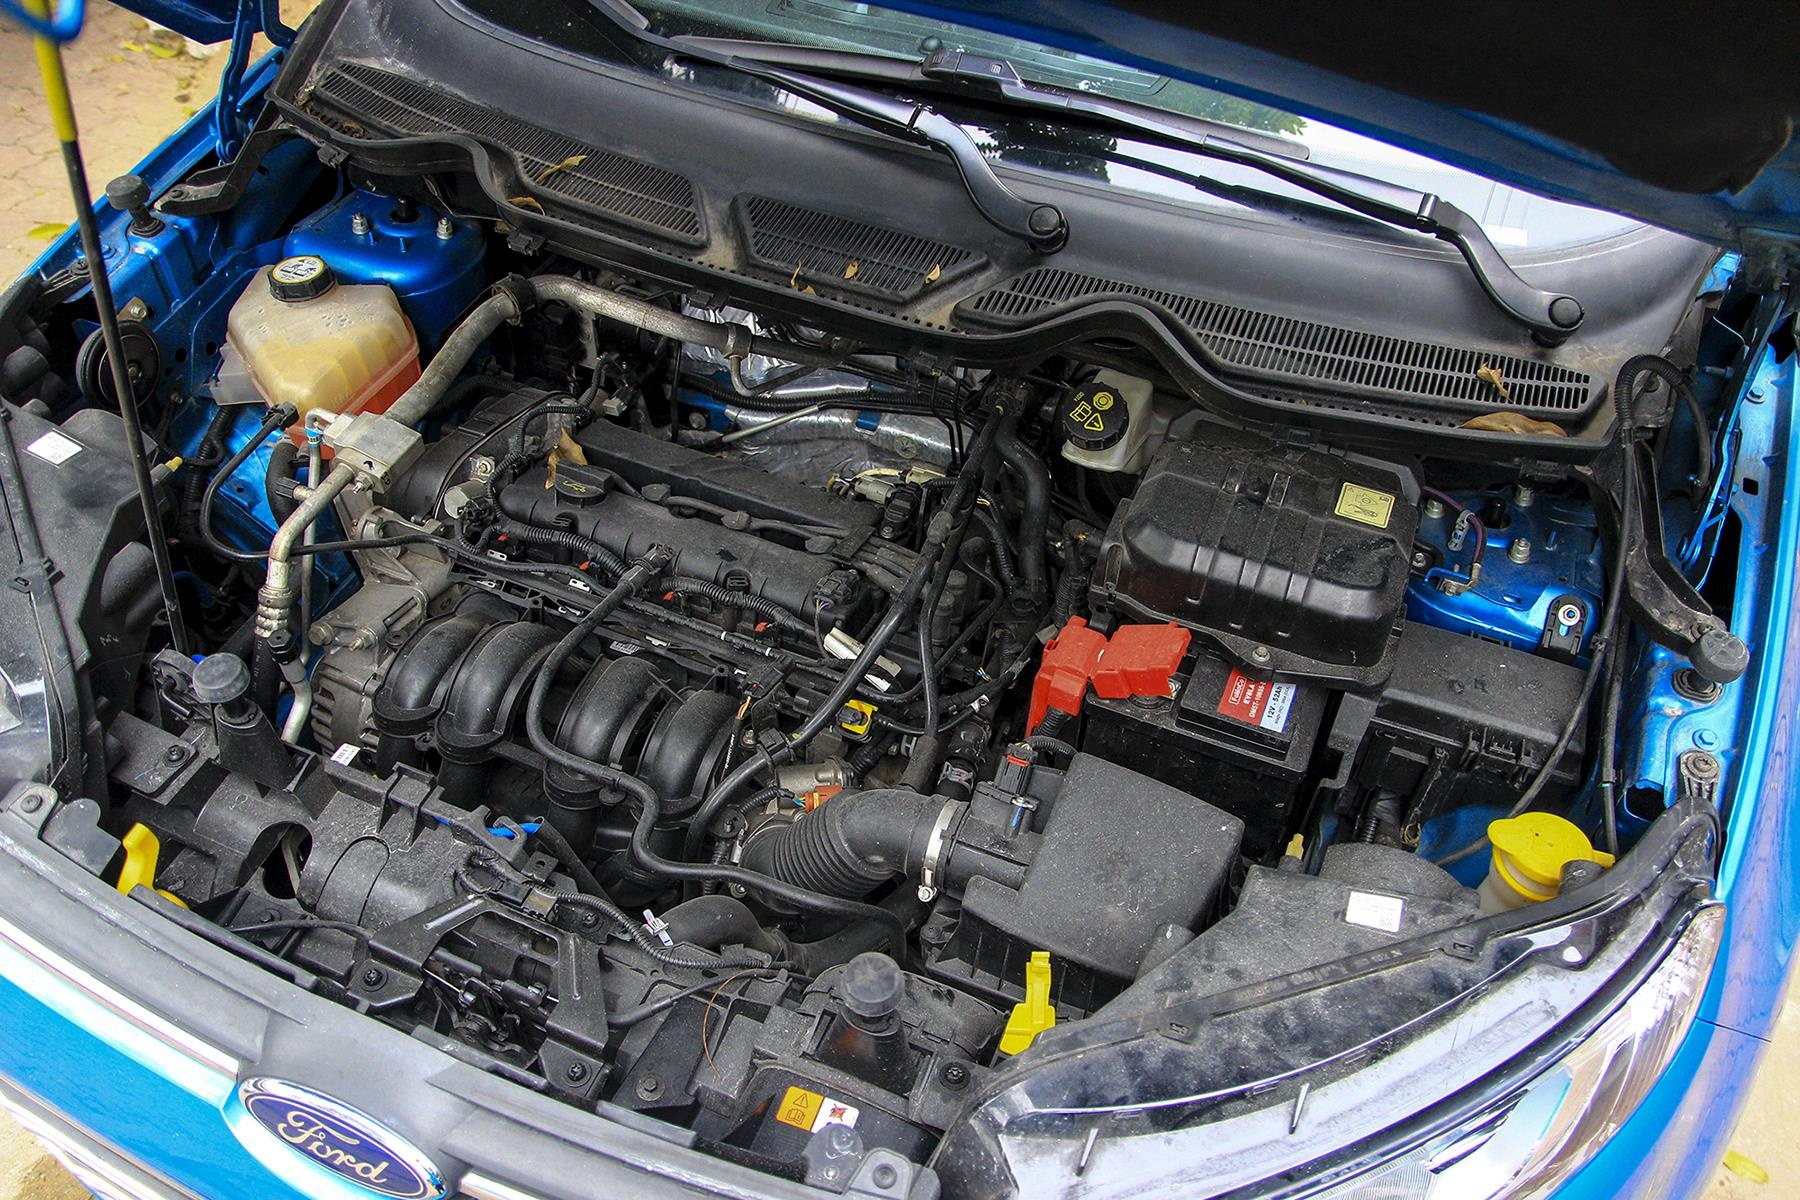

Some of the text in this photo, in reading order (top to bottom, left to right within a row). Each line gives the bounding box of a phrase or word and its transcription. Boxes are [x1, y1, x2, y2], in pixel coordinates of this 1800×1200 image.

[1230, 679, 1245, 702] FoMoCo
[1267, 705, 1276, 718] 12V
[278, 1110, 390, 1183] Ford
